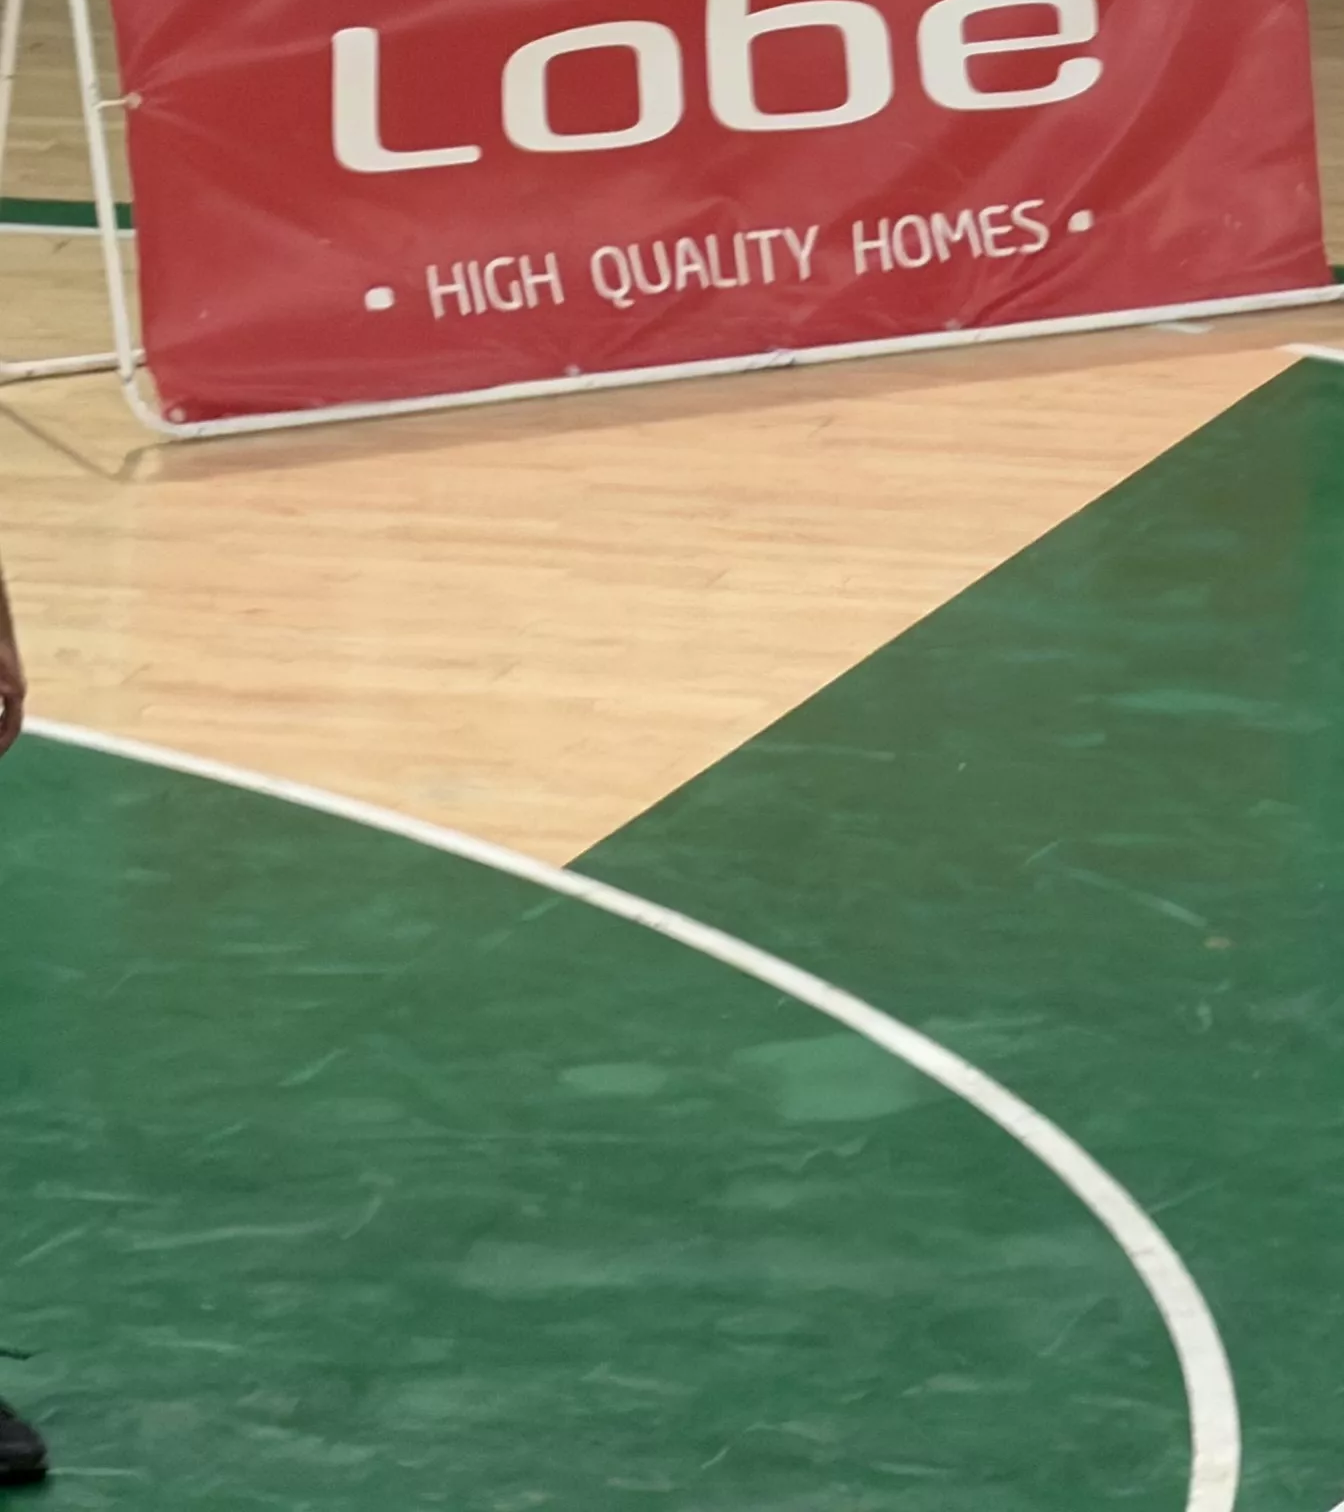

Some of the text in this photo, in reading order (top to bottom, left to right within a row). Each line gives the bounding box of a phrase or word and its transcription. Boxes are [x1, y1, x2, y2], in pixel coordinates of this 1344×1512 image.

[428, 198, 1051, 318] HIGH QUALITY HOMES
